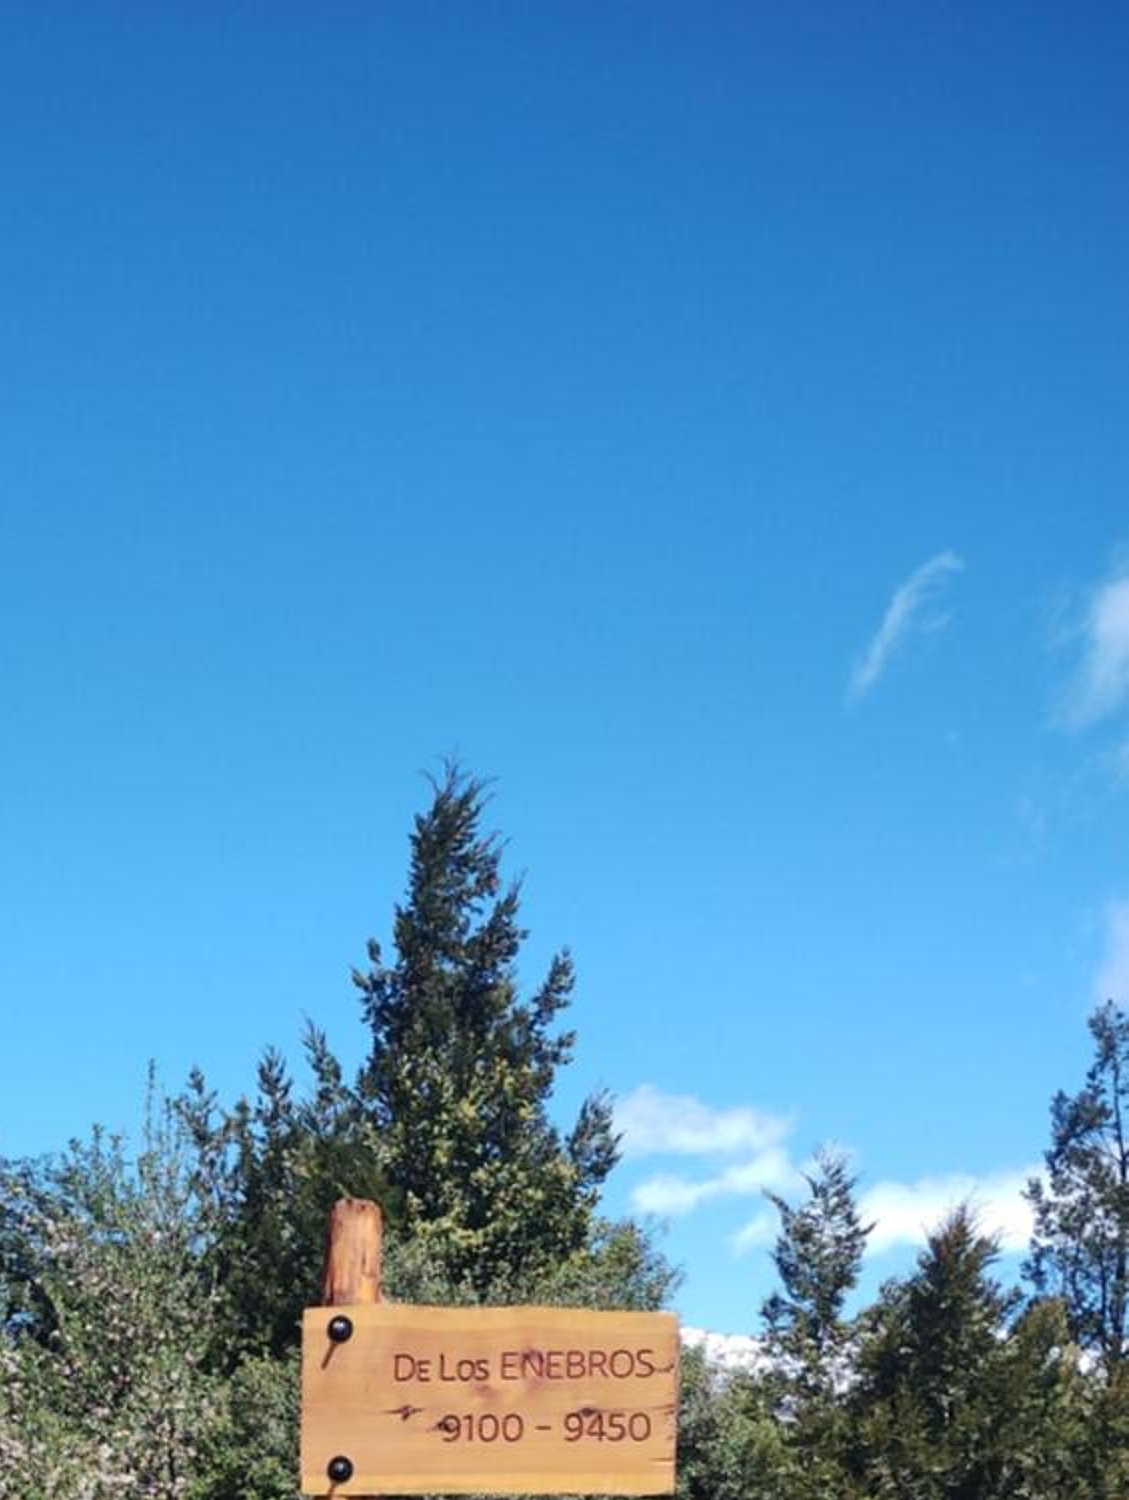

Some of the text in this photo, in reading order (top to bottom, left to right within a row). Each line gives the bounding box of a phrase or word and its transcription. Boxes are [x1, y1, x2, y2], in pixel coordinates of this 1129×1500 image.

[501, 1349, 655, 1380] ENEBROS
[442, 1412, 525, 1443] 9100
[564, 1411, 653, 1442] 9450
